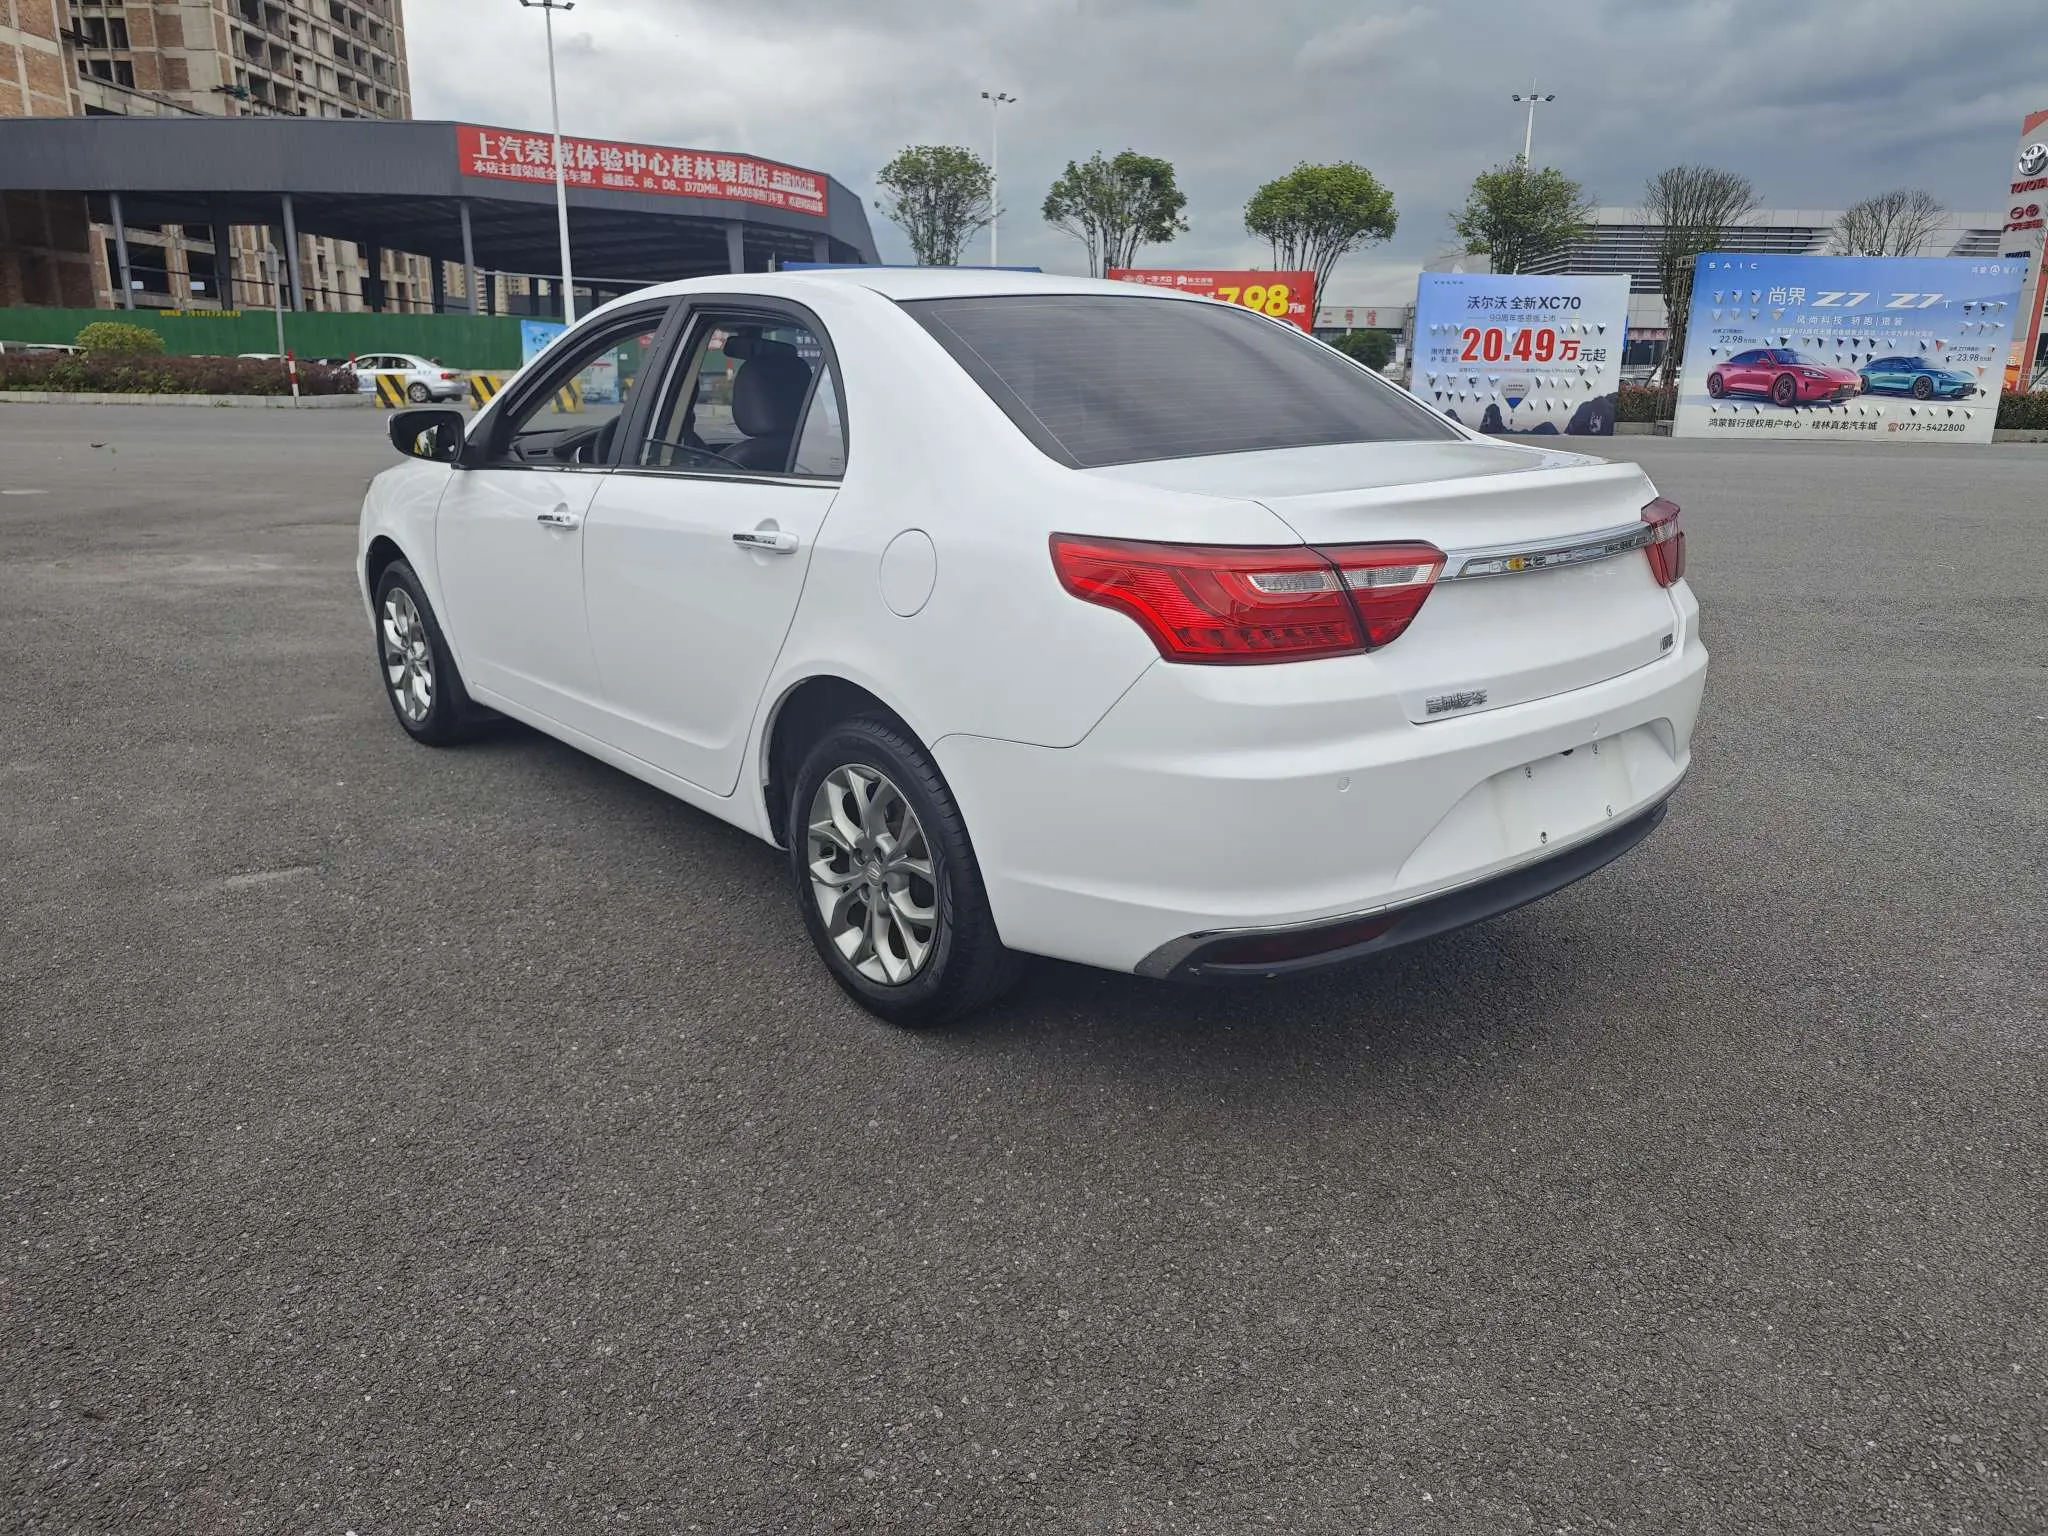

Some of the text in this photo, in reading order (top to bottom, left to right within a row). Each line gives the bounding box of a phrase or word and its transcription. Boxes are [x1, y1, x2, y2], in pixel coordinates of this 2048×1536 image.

[2010, 177, 2048, 194] TOYOTA
[1708, 262, 1758, 270] SAIC
[1768, 286, 1806, 305] 尚界
[1810, 291, 1871, 307] Z7
[1898, 423, 1966, 432] 0773-5422800
